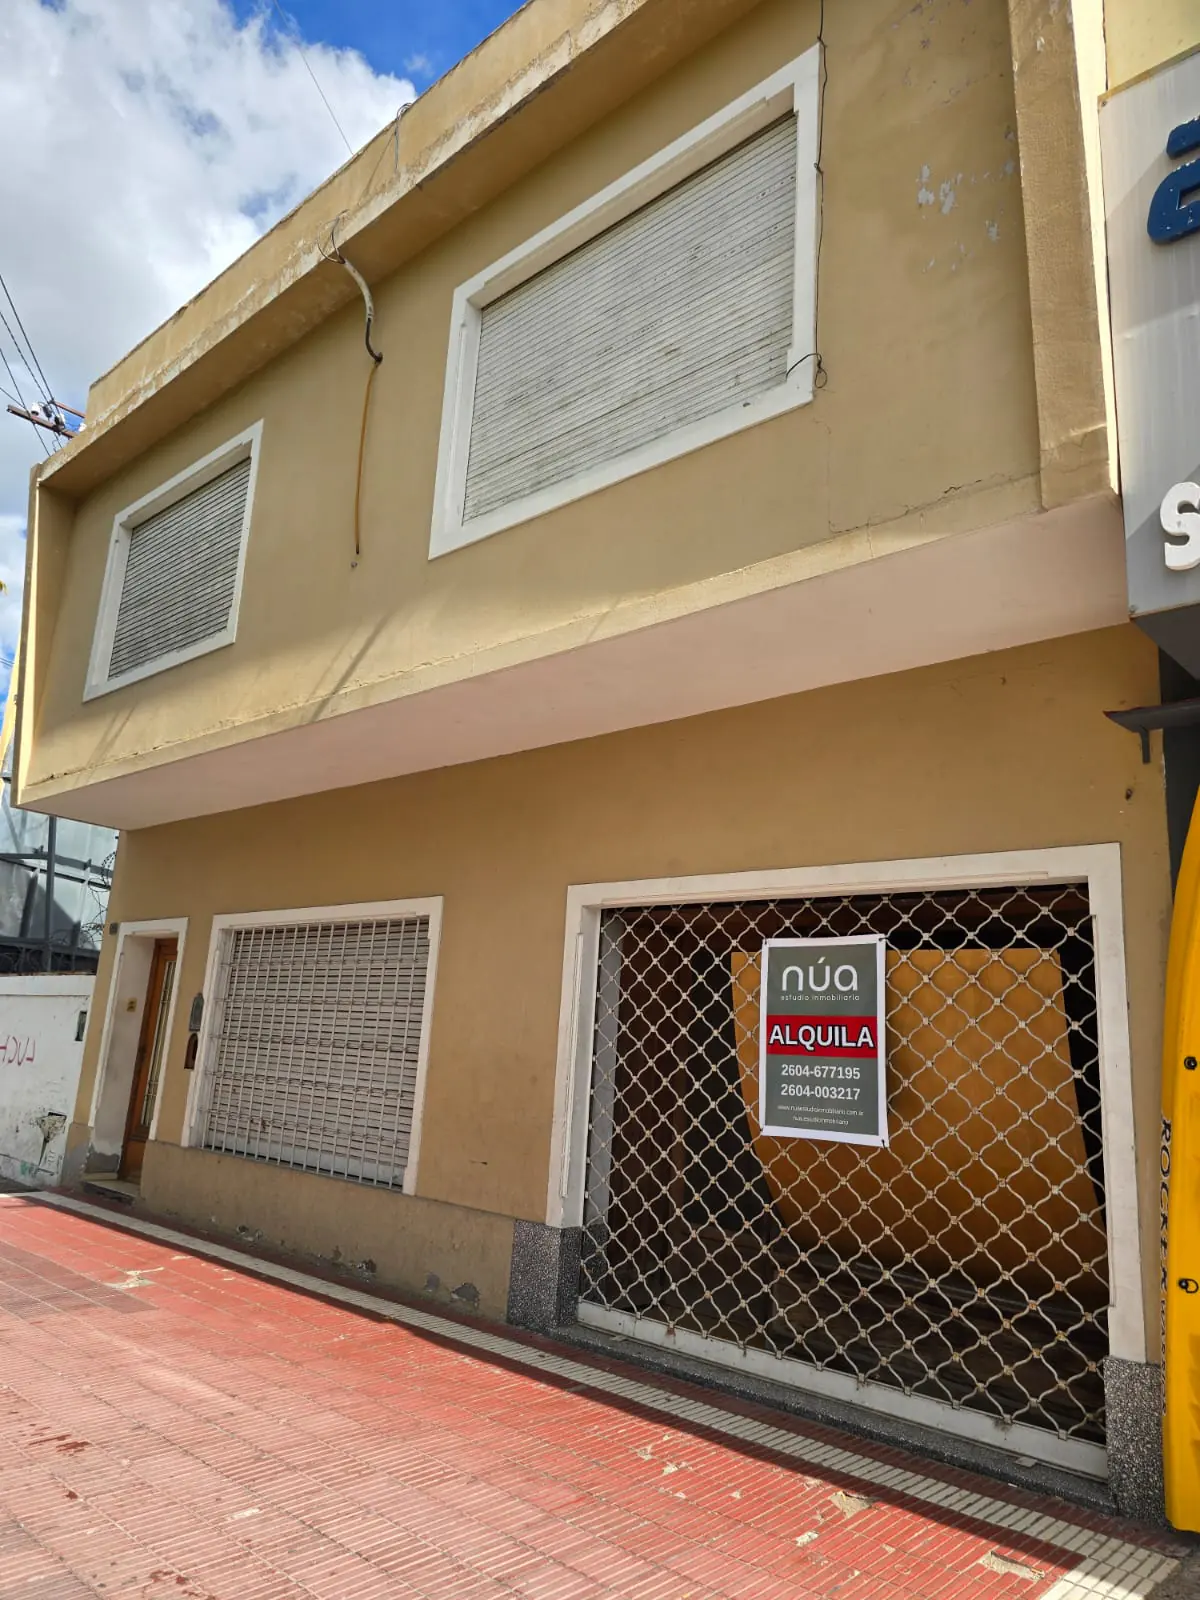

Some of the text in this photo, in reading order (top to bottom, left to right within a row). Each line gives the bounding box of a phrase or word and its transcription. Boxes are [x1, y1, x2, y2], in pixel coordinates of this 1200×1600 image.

[781, 956, 859, 992] núa
[780, 994, 810, 1002] estudio
[769, 1024, 876, 1051] ALQUILA
[780, 1064, 861, 1080] 2604-677195
[780, 1083, 861, 1100] 2604-003217
